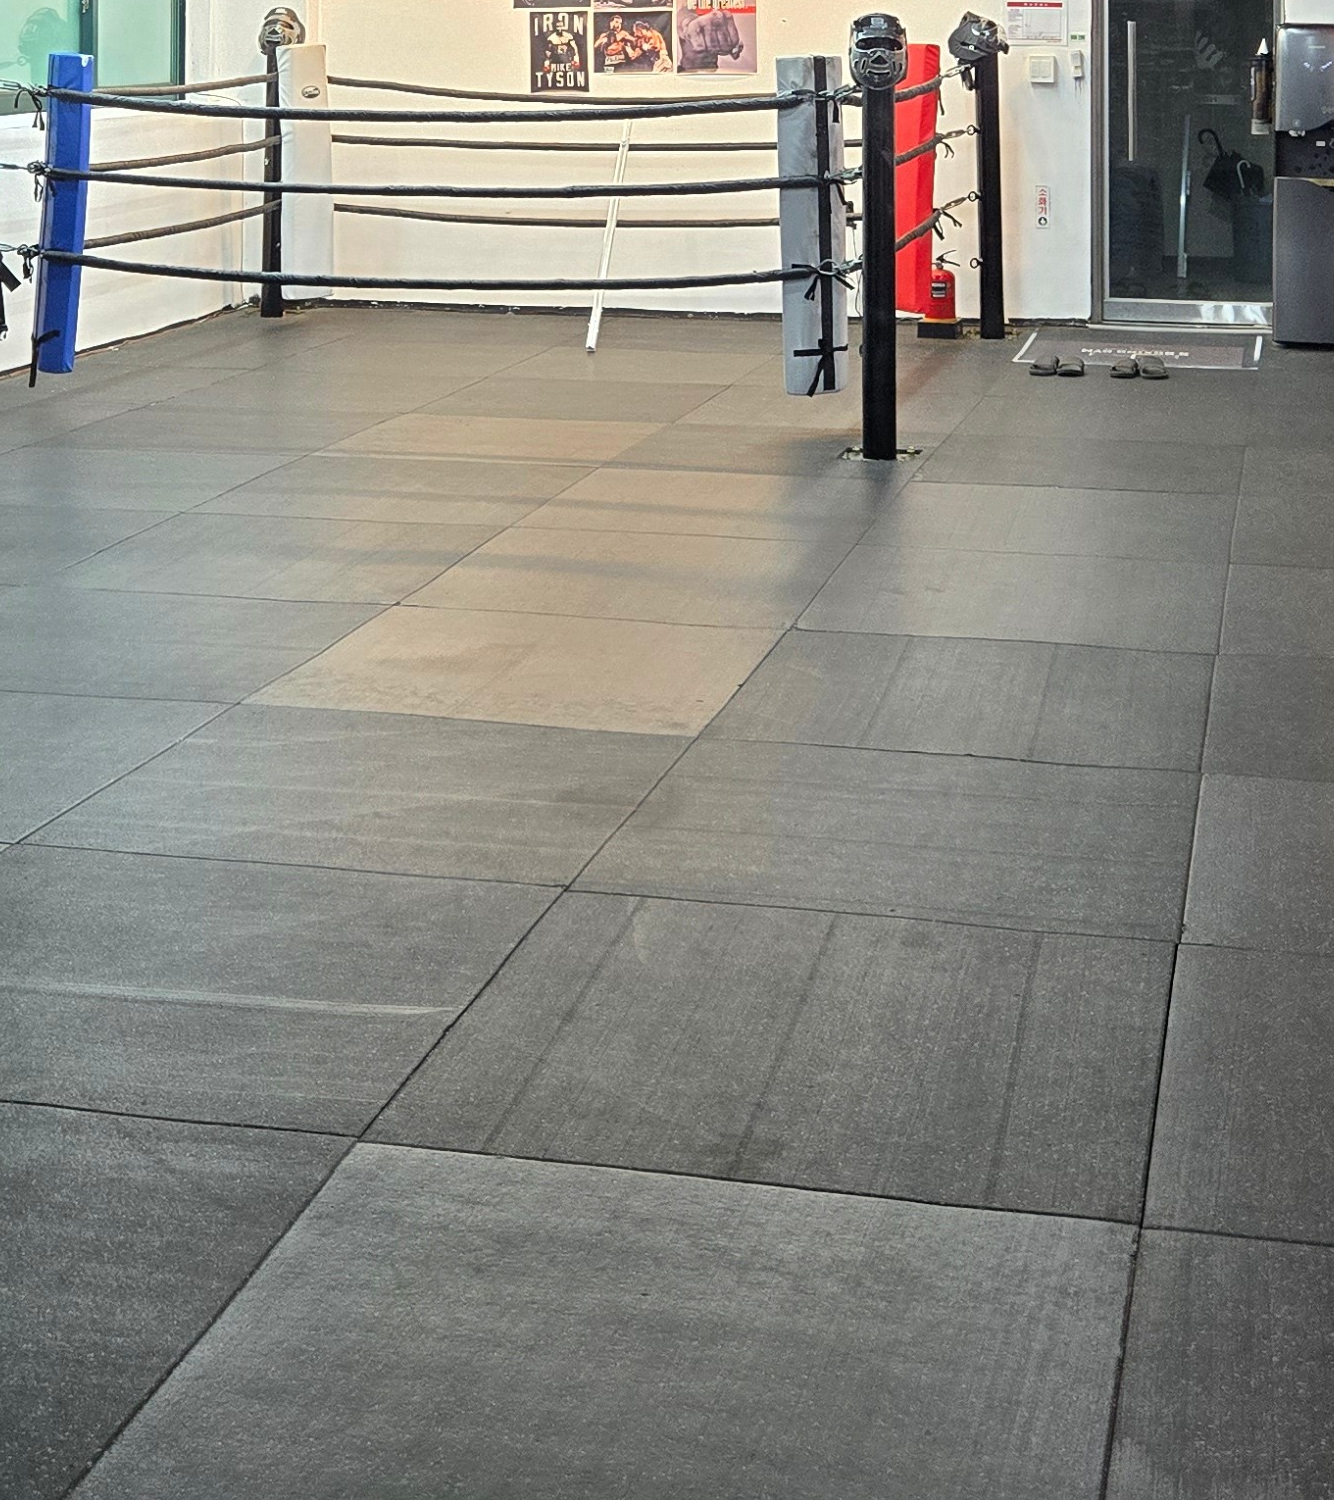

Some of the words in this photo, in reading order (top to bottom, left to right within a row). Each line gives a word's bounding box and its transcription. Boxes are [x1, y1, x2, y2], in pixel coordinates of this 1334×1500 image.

[534, 13, 584, 36] IRON
[551, 63, 572, 72] MIKE
[535, 71, 585, 87] TYSON
[1038, 188, 1047, 216] 소화기
